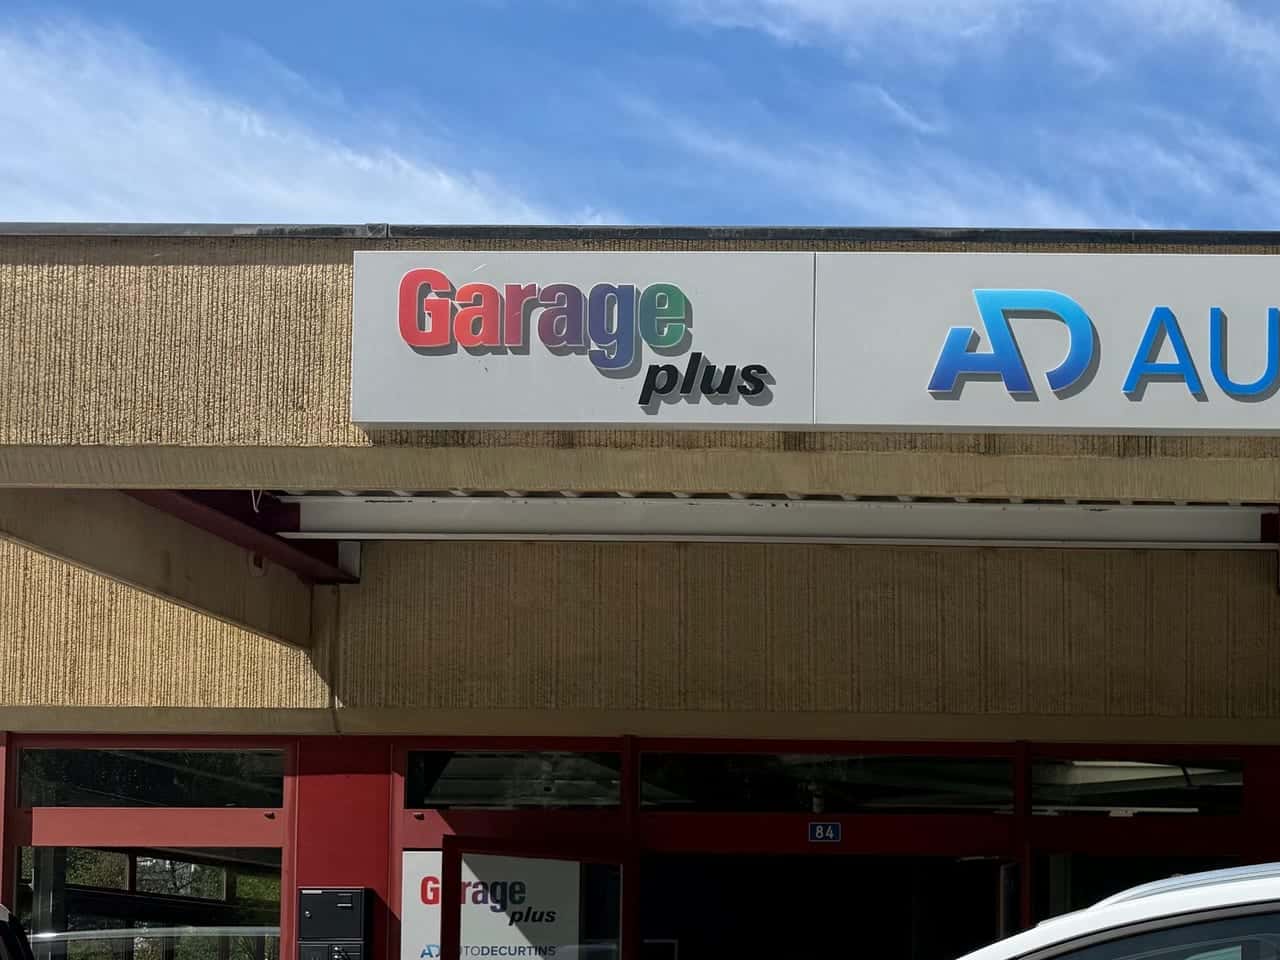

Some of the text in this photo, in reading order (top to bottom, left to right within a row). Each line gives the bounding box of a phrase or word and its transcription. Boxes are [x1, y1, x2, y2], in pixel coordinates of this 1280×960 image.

[398, 267, 688, 370] Garage
[638, 351, 768, 406] plus
[815, 825, 835, 839] 84
[420, 875, 526, 912] Grage
[508, 906, 556, 926] plus
